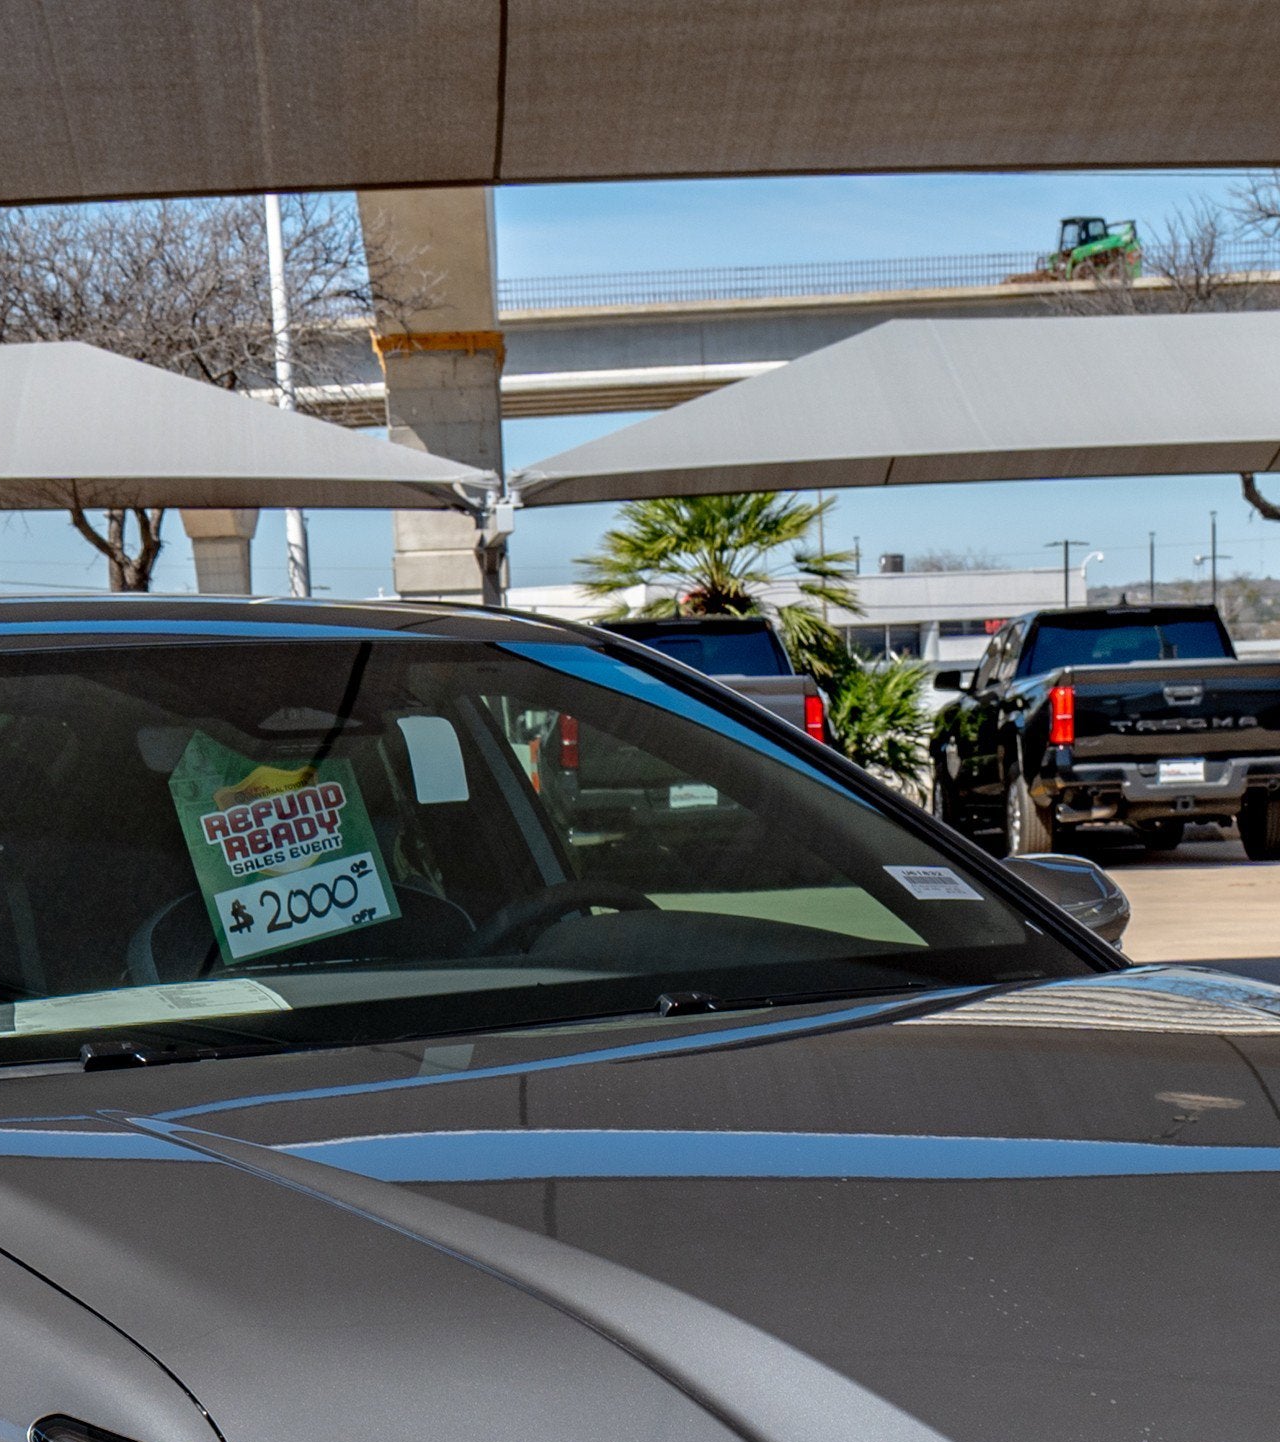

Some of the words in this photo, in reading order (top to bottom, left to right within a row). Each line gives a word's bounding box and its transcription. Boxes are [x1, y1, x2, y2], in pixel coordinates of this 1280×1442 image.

[1110, 716, 1258, 733] TACOMA
[202, 783, 345, 841] REFUND
[222, 809, 340, 862] READY
[232, 851, 286, 875] SALES
[290, 835, 341, 859] EVENT
[352, 906, 377, 924] OFF
